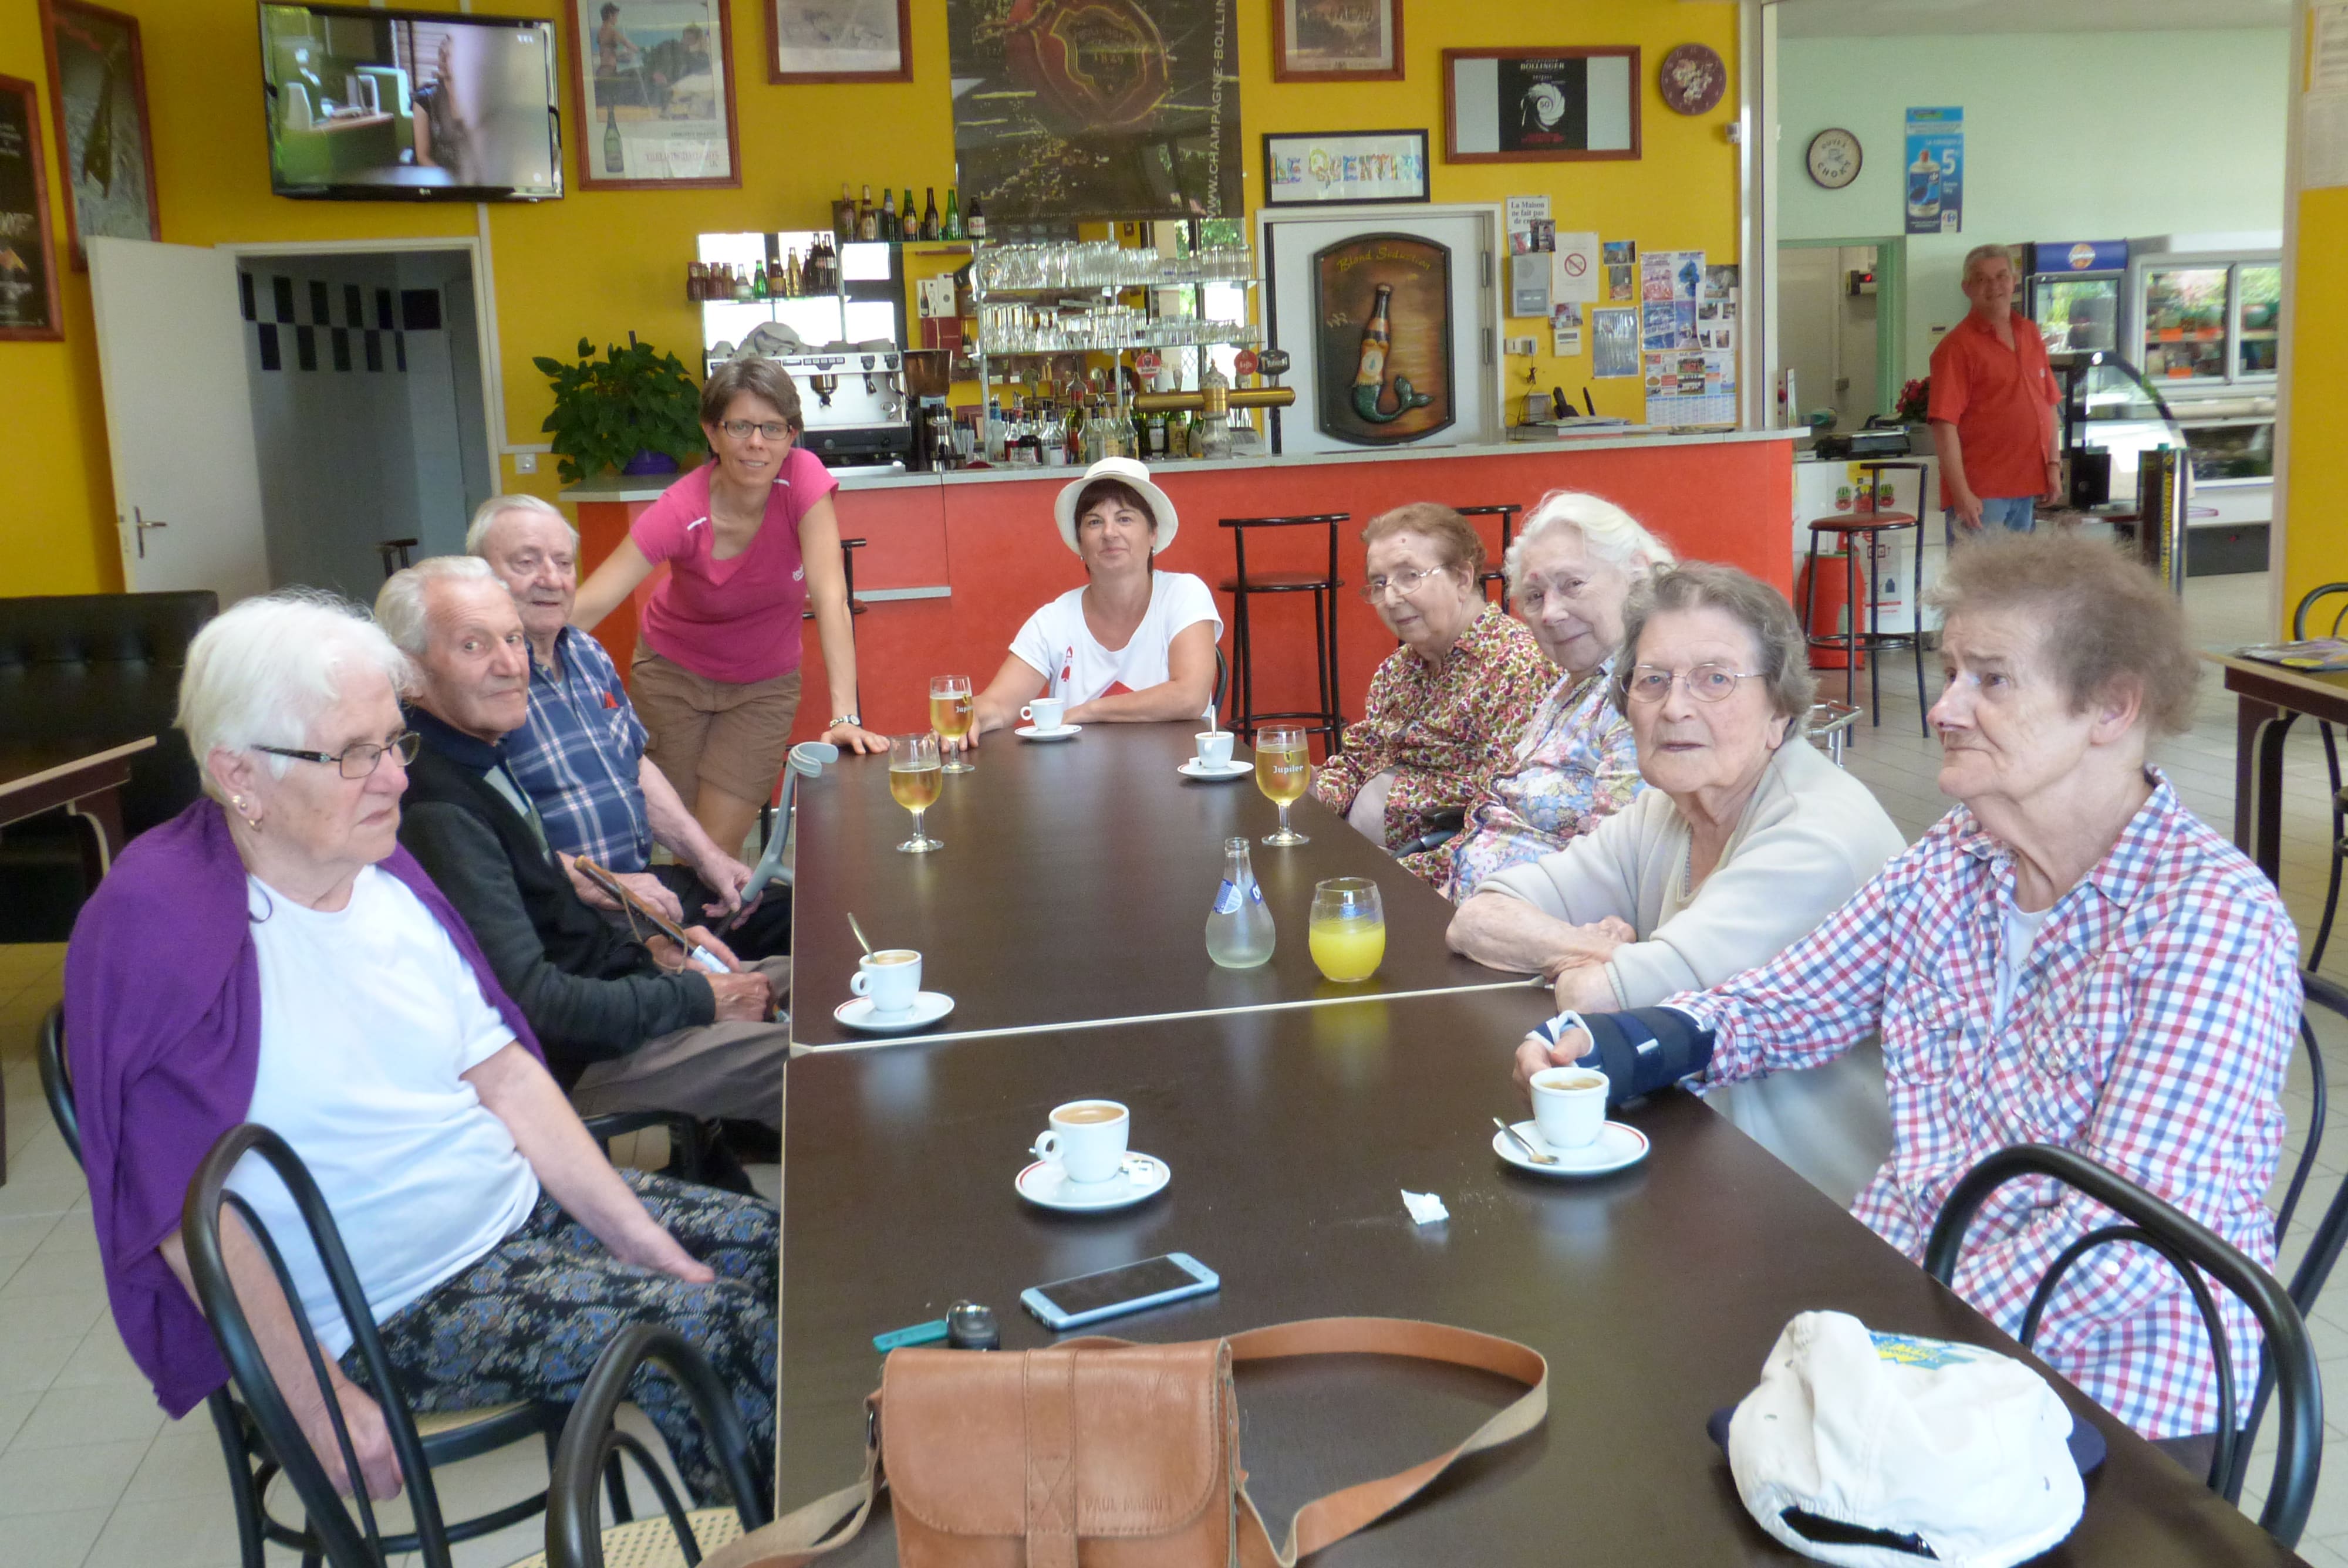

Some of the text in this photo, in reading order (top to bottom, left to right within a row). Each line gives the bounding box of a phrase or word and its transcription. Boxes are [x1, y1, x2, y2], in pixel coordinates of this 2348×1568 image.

[1520, 62, 1564, 70] BOLLINGER
[1065, 646, 1073, 663] A
[1273, 765, 1304, 775] Jupiler
